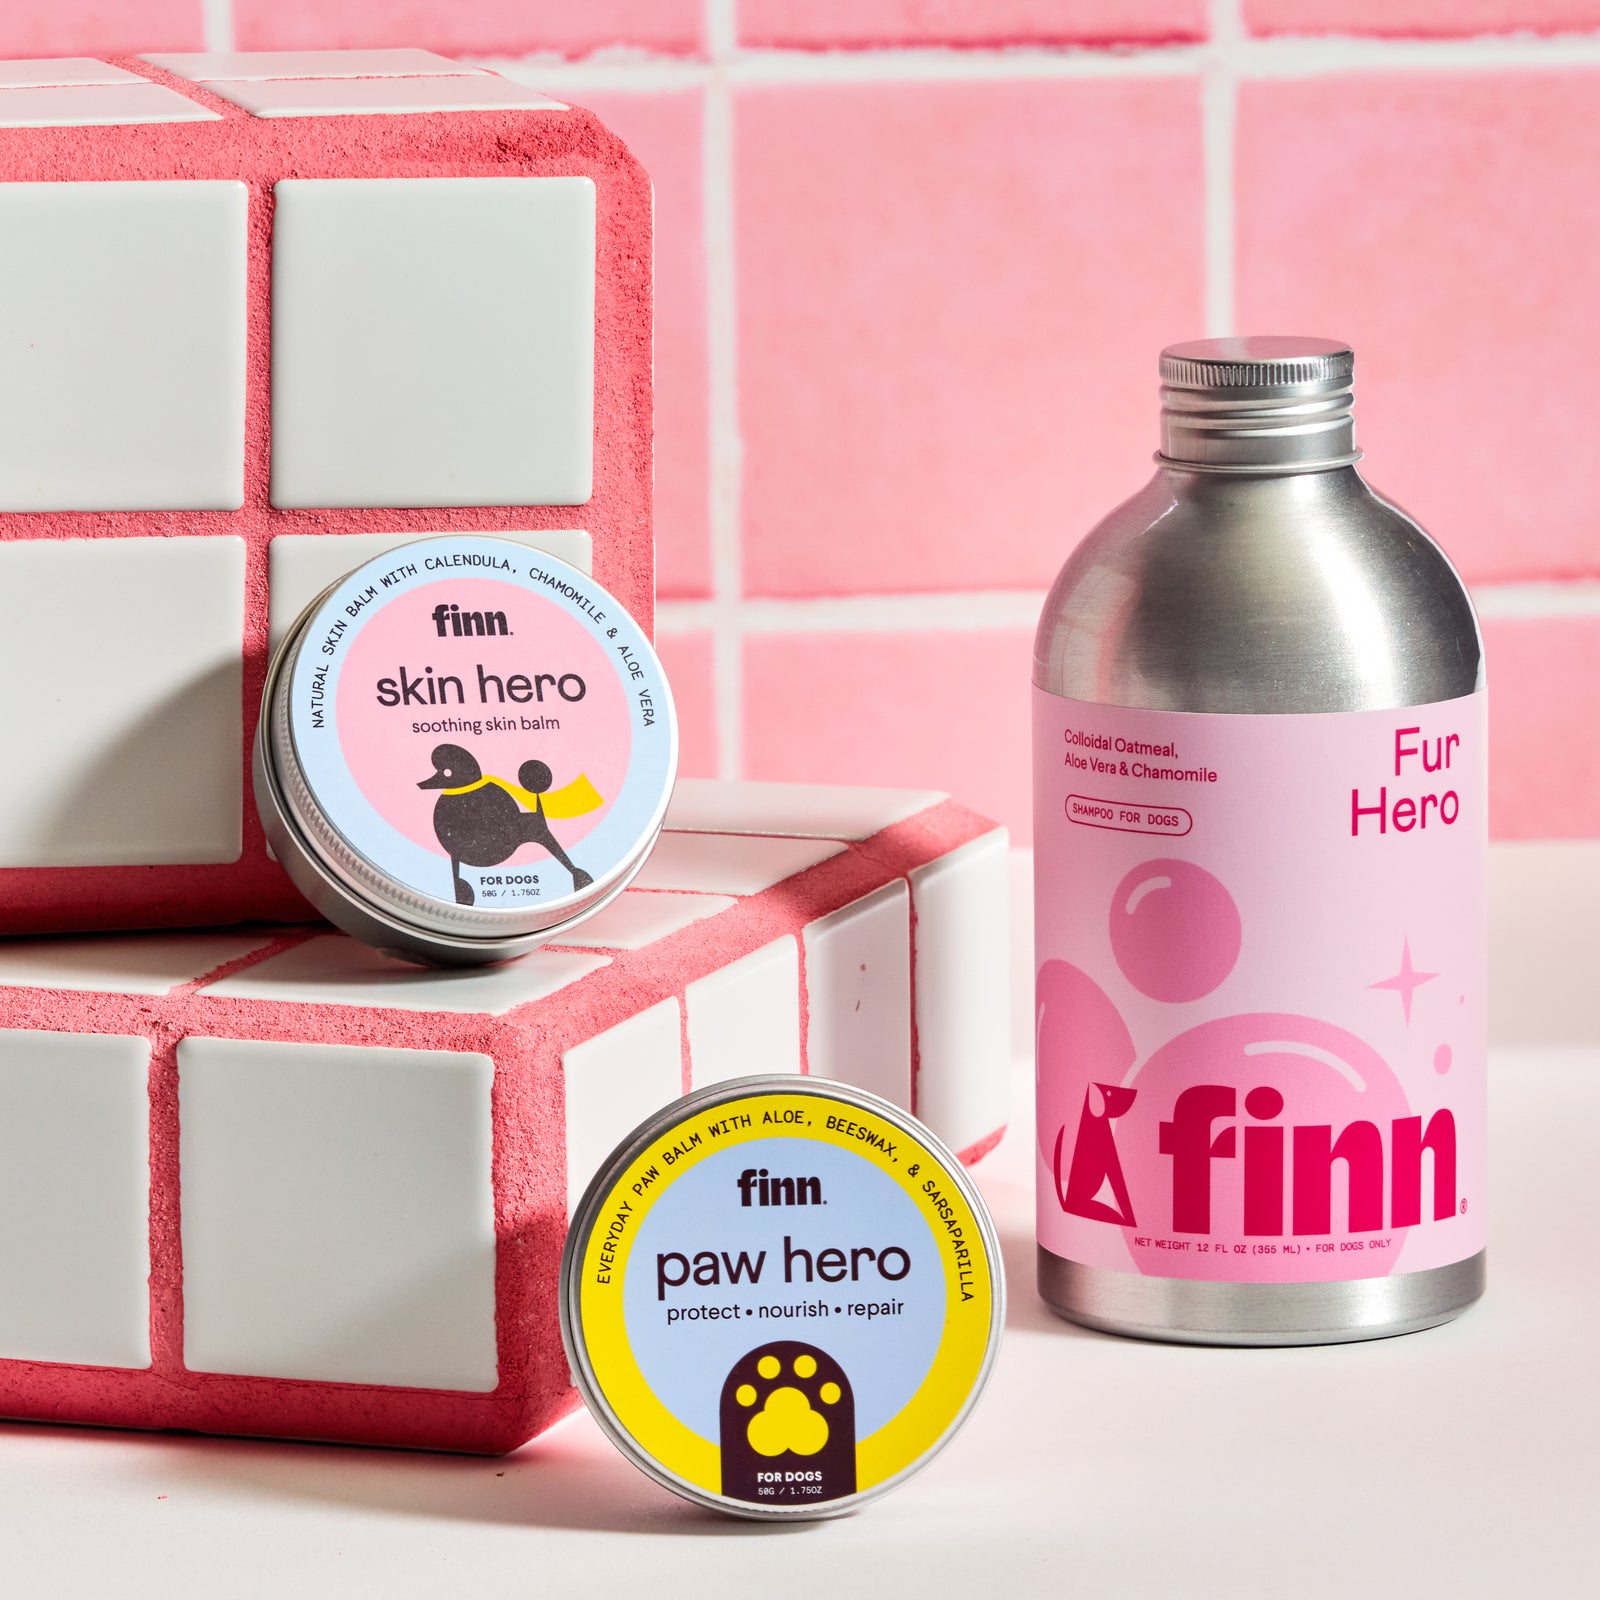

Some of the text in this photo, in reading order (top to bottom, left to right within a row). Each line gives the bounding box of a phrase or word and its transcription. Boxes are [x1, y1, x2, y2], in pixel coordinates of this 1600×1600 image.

[311, 554, 655, 728] NATURAL SKIN BALM WITH CALENDULA, CHAMOMILE & ALOE VERA
[376, 664, 586, 707] skin hero
[412, 716, 560, 735] soothing skin balm
[1064, 729, 1179, 759] Colloidal Oatmeal,
[1395, 726, 1460, 776] Fur
[1064, 752, 1218, 783] Aloe Vera & Chamomile
[1072, 802, 1179, 827] SHAMPOO FOR DOGS
[1351, 786, 1459, 837] Hero
[480, 875, 539, 885] FOR DOGS
[511, 888, 541, 896] 1.75OZ
[597, 1110, 974, 1302] EVERYDAY PAW BALM WITH ALOE, BEESWAX, & SARSAPARILLA
[1134, 1237, 1151, 1247] NET
[1155, 1239, 1190, 1251] WEIGHT
[1197, 1243, 1209, 1252] 12
[1215, 1244, 1227, 1253] FL
[1234, 1245, 1246, 1253] OZ
[1283, 1244, 1301, 1255] ML)
[1315, 1243, 1335, 1253] FOR
[1340, 1241, 1364, 1251] DOGS
[1369, 1239, 1391, 1249] ONLY
[657, 1236, 911, 1301] paw hero
[667, 1298, 904, 1325] protect nourish repair
[757, 1471, 822, 1483] FOR DOGS
[790, 1486, 823, 1495] 1.75OZ
